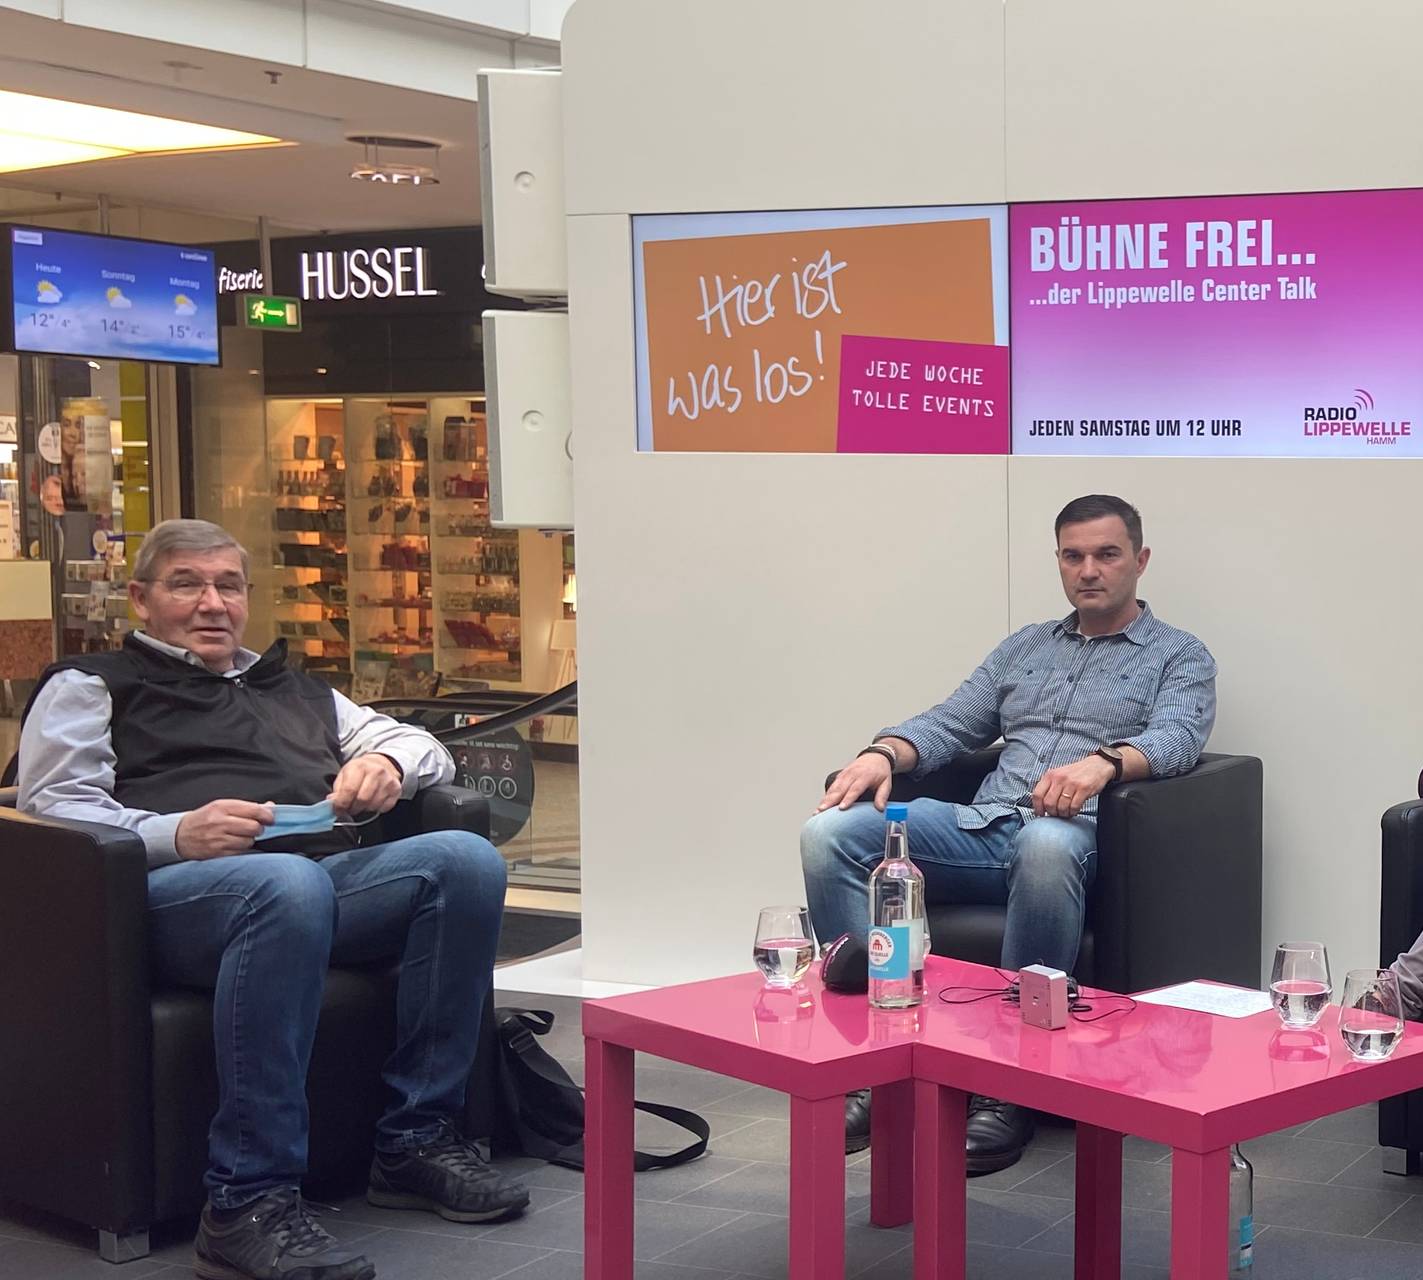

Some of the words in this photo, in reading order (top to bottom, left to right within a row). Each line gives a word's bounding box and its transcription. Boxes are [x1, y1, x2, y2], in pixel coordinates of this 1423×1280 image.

[1030, 216, 1169, 272] BÜHNE
[1186, 219, 1316, 268] FREI...
[35, 263, 62, 274] Heute
[101, 269, 135, 283] Sonntag
[302, 247, 438, 300] HUSSEL
[169, 277, 200, 290] Montag
[697, 274, 781, 338] Hier
[792, 250, 847, 318] ist
[1029, 282, 1081, 305] ...der
[1088, 281, 1195, 309] Lippewelle
[1202, 278, 1271, 302] Center
[1277, 276, 1317, 300] Talk
[668, 364, 742, 420] was
[754, 330, 825, 403] los!
[866, 361, 911, 380] JEDE
[925, 364, 984, 386] WOCHE
[853, 389, 910, 411] TOLLE
[923, 395, 994, 417] EVENTS
[1304, 407, 1357, 421] RADIO
[1029, 420, 1075, 437] JEDEN
[1080, 420, 1151, 437] SAMSTAG
[1155, 420, 1181, 437] UM
[1186, 420, 1205, 437] 12
[1211, 420, 1242, 437] UHR
[1303, 422, 1411, 437] LIPPEWELLE
[1366, 436, 1397, 445] HAMM
